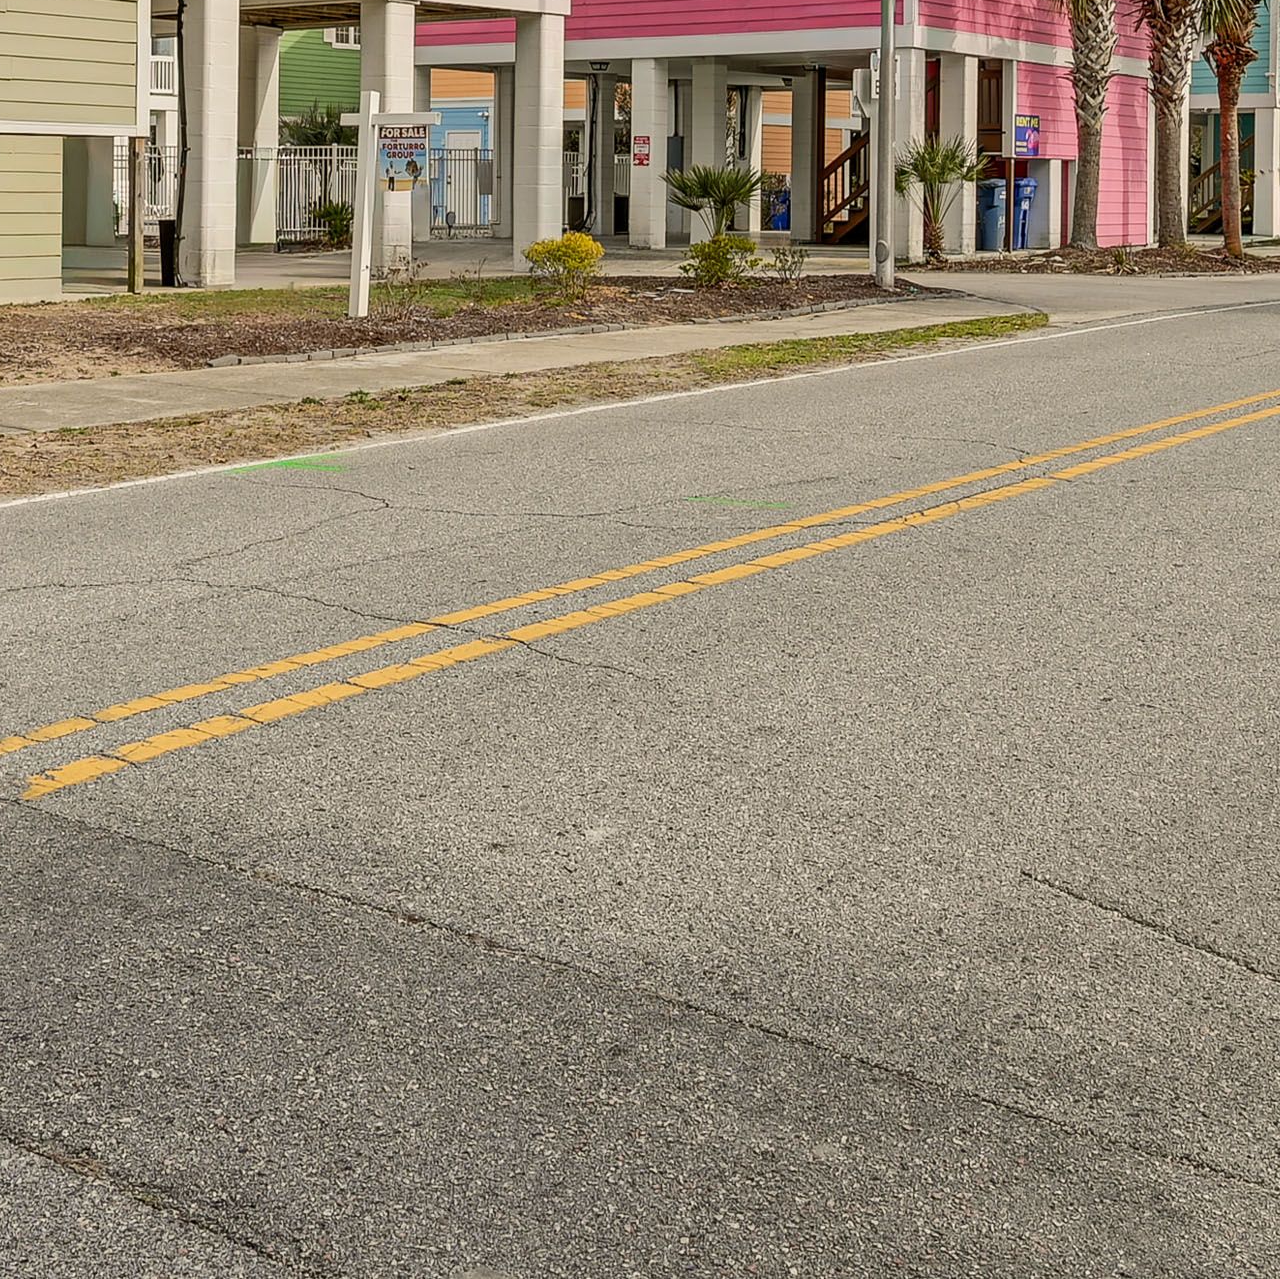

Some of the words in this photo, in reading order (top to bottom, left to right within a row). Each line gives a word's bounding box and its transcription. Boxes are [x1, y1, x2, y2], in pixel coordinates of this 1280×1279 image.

[381, 128, 401, 138] FOR
[401, 128, 425, 138] SALE
[382, 143, 426, 151] FORTURRO
[386, 151, 414, 159] GROUP
